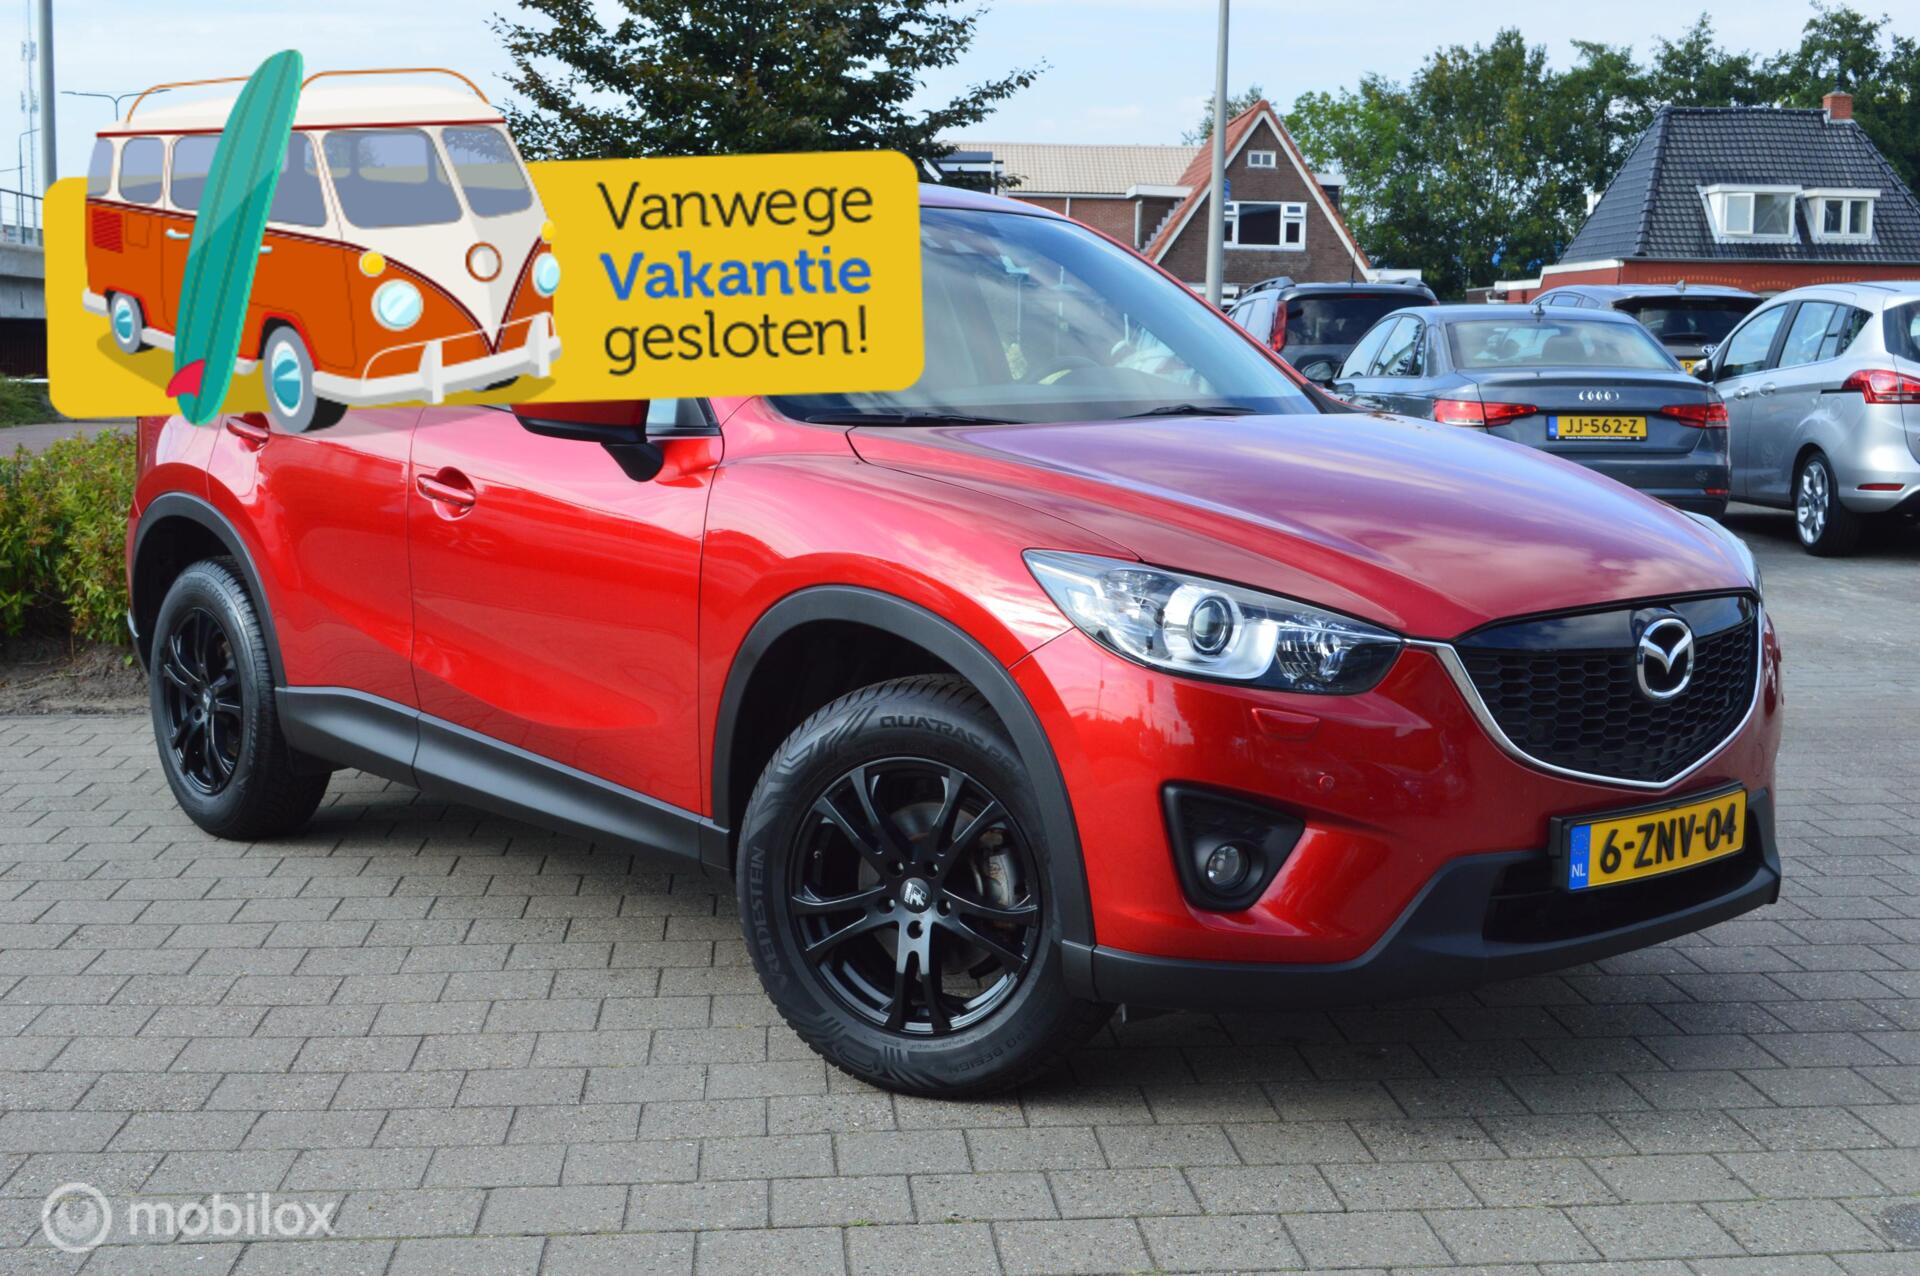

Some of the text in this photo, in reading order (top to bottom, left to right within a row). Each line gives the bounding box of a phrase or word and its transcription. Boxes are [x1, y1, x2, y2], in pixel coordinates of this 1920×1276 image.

[1565, 417, 1639, 434] JJ-562-Z
[879, 715, 985, 750] QUATRAC
[1600, 803, 1738, 874] 6-ZNV-04
[1571, 863, 1586, 878] NL
[749, 846, 788, 990] VREDESTEIN
